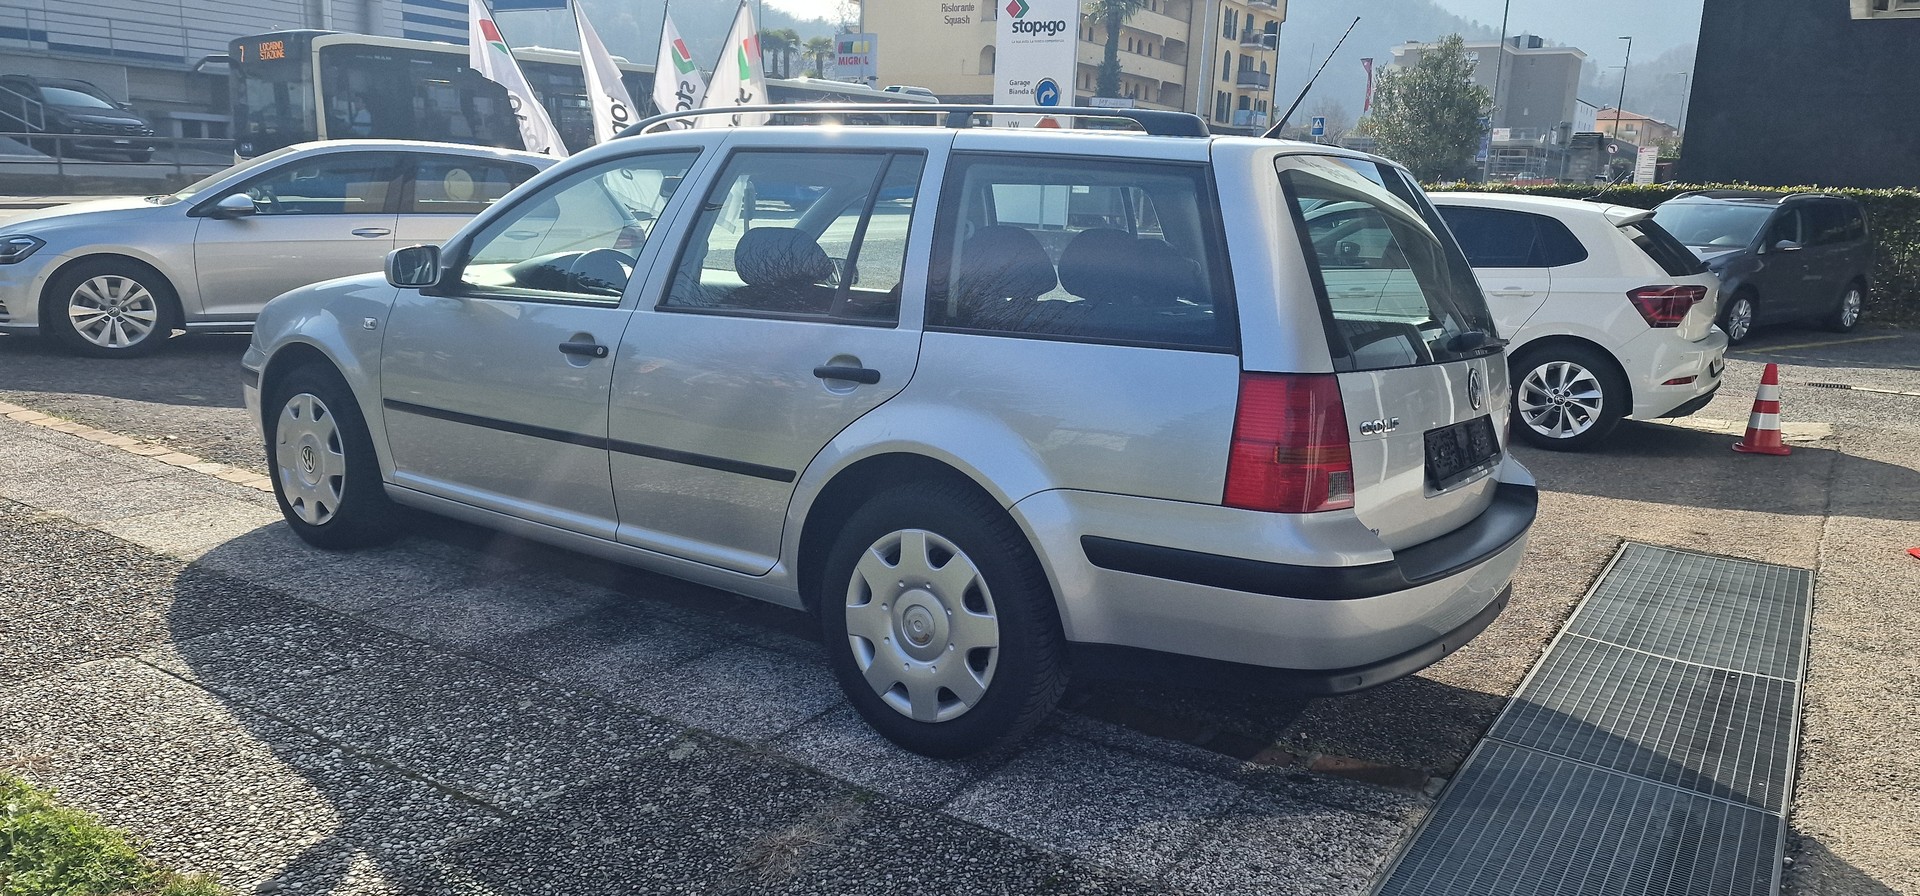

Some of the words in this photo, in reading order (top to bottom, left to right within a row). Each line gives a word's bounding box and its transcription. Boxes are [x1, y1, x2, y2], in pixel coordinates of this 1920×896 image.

[941, 2, 975, 12] Ristorante
[944, 15, 970, 26] Squash
[1012, 19, 1066, 36] stop+go
[239, 45, 244, 62] 7
[1360, 416, 1399, 436] GOLF
